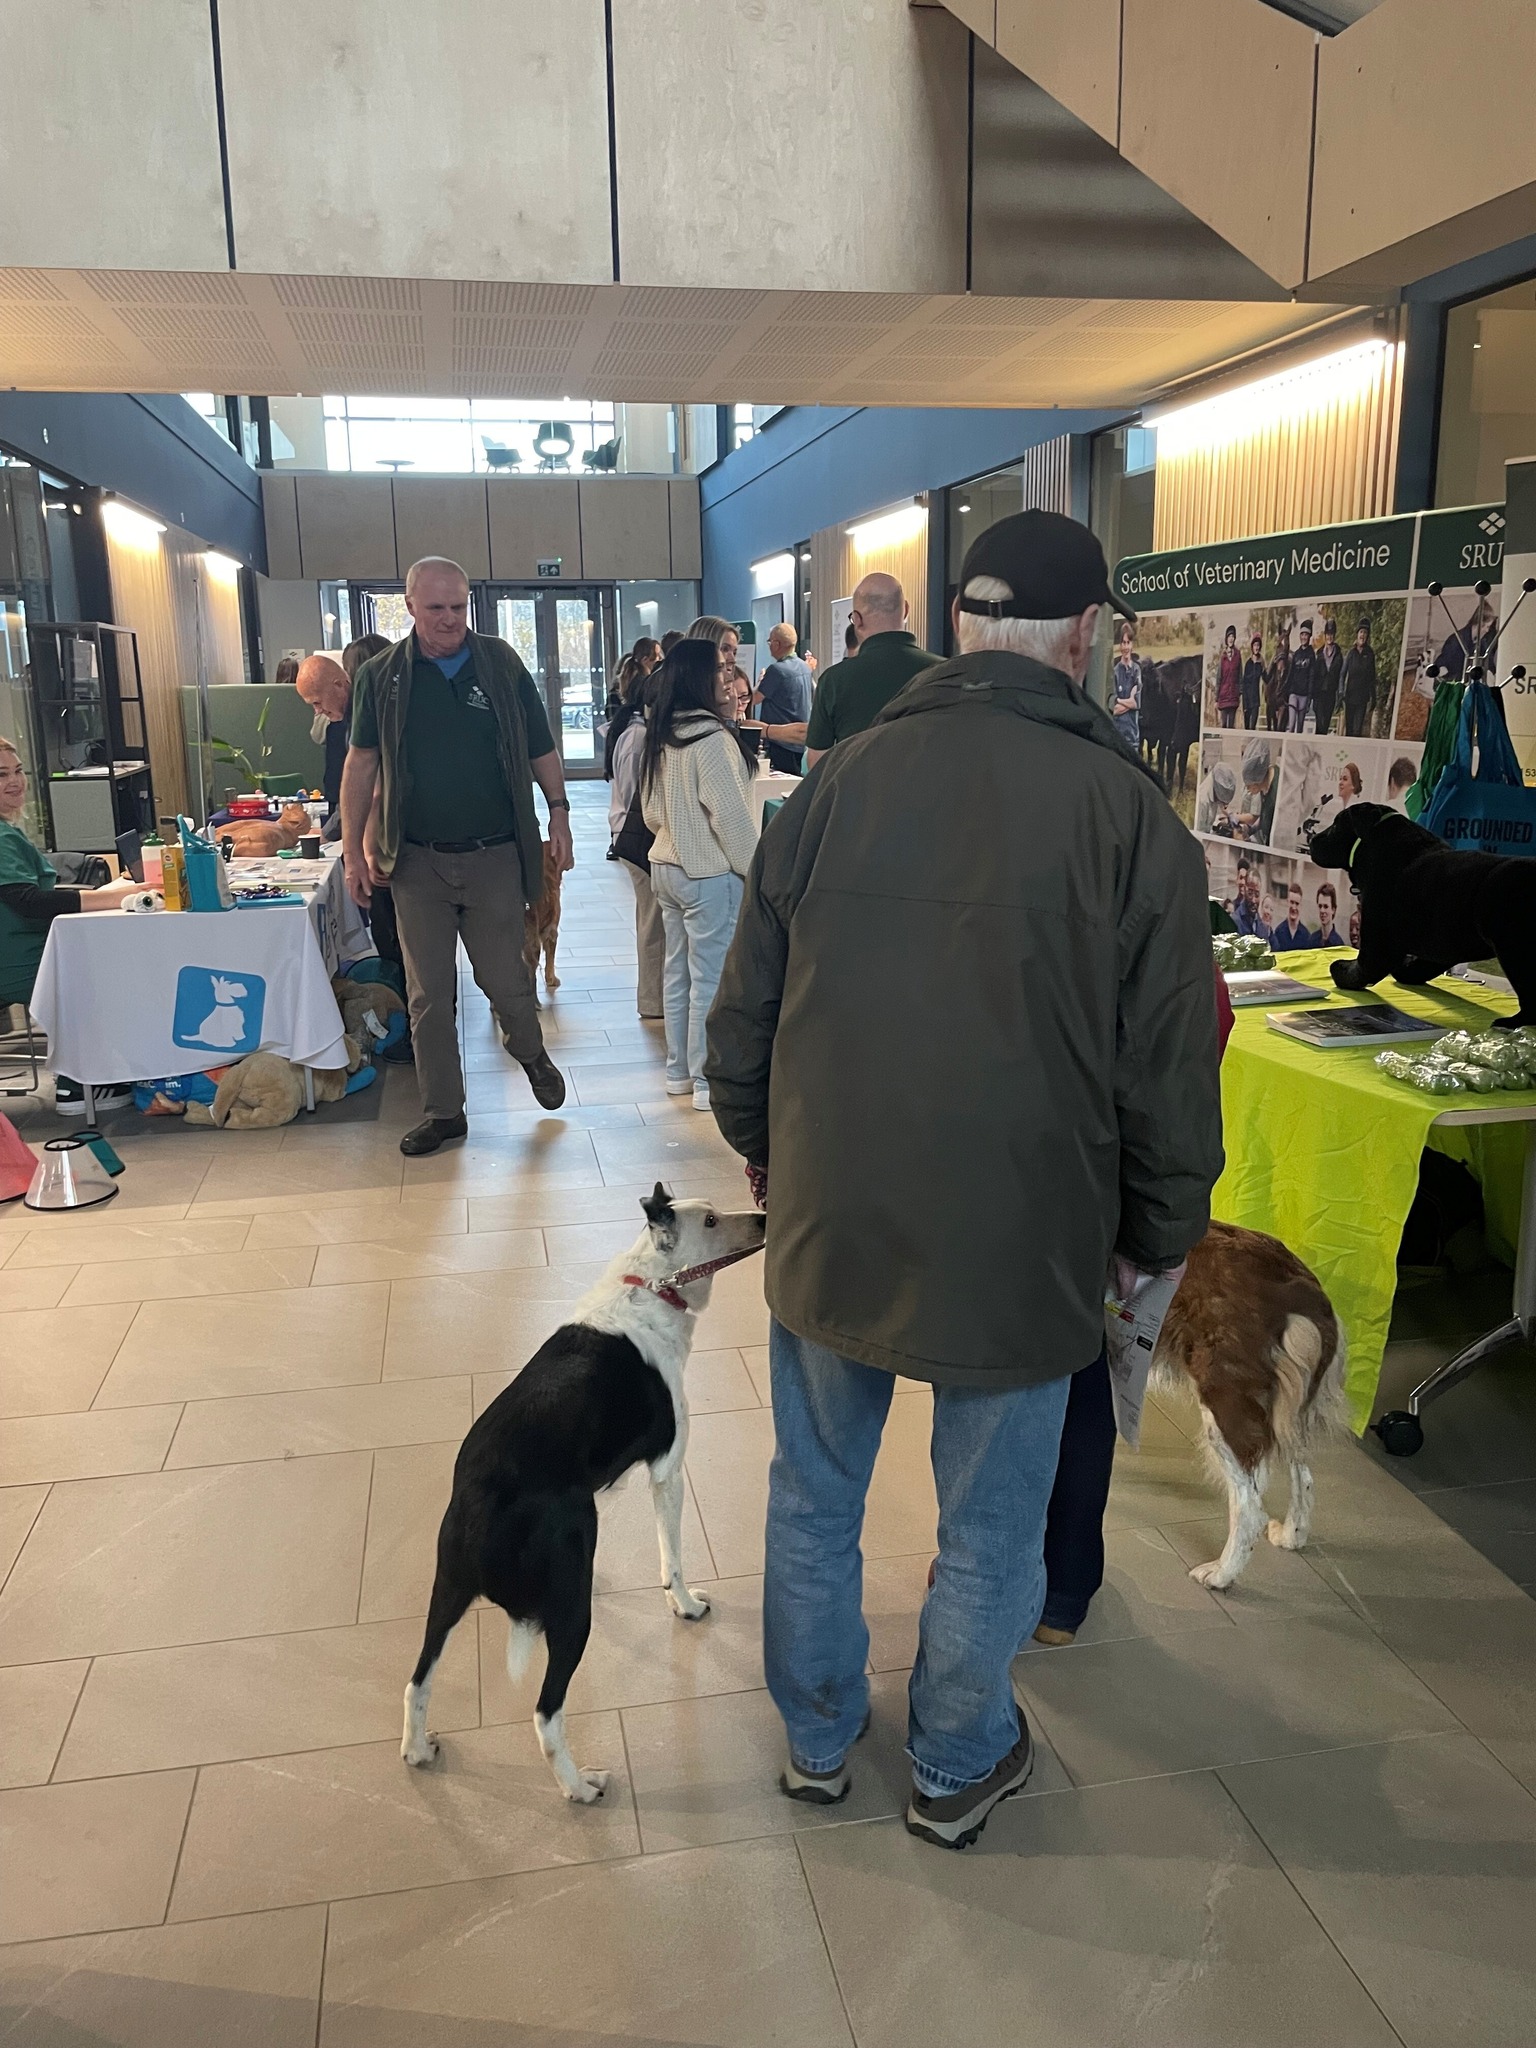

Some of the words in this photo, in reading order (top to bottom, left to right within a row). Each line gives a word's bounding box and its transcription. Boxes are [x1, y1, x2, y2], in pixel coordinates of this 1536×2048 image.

[1121, 567, 1172, 594] School
[1174, 564, 1191, 589] of
[1194, 556, 1286, 586] Veterinary
[1291, 540, 1391, 576] Medicine
[1443, 817, 1534, 844] GROUNDED
